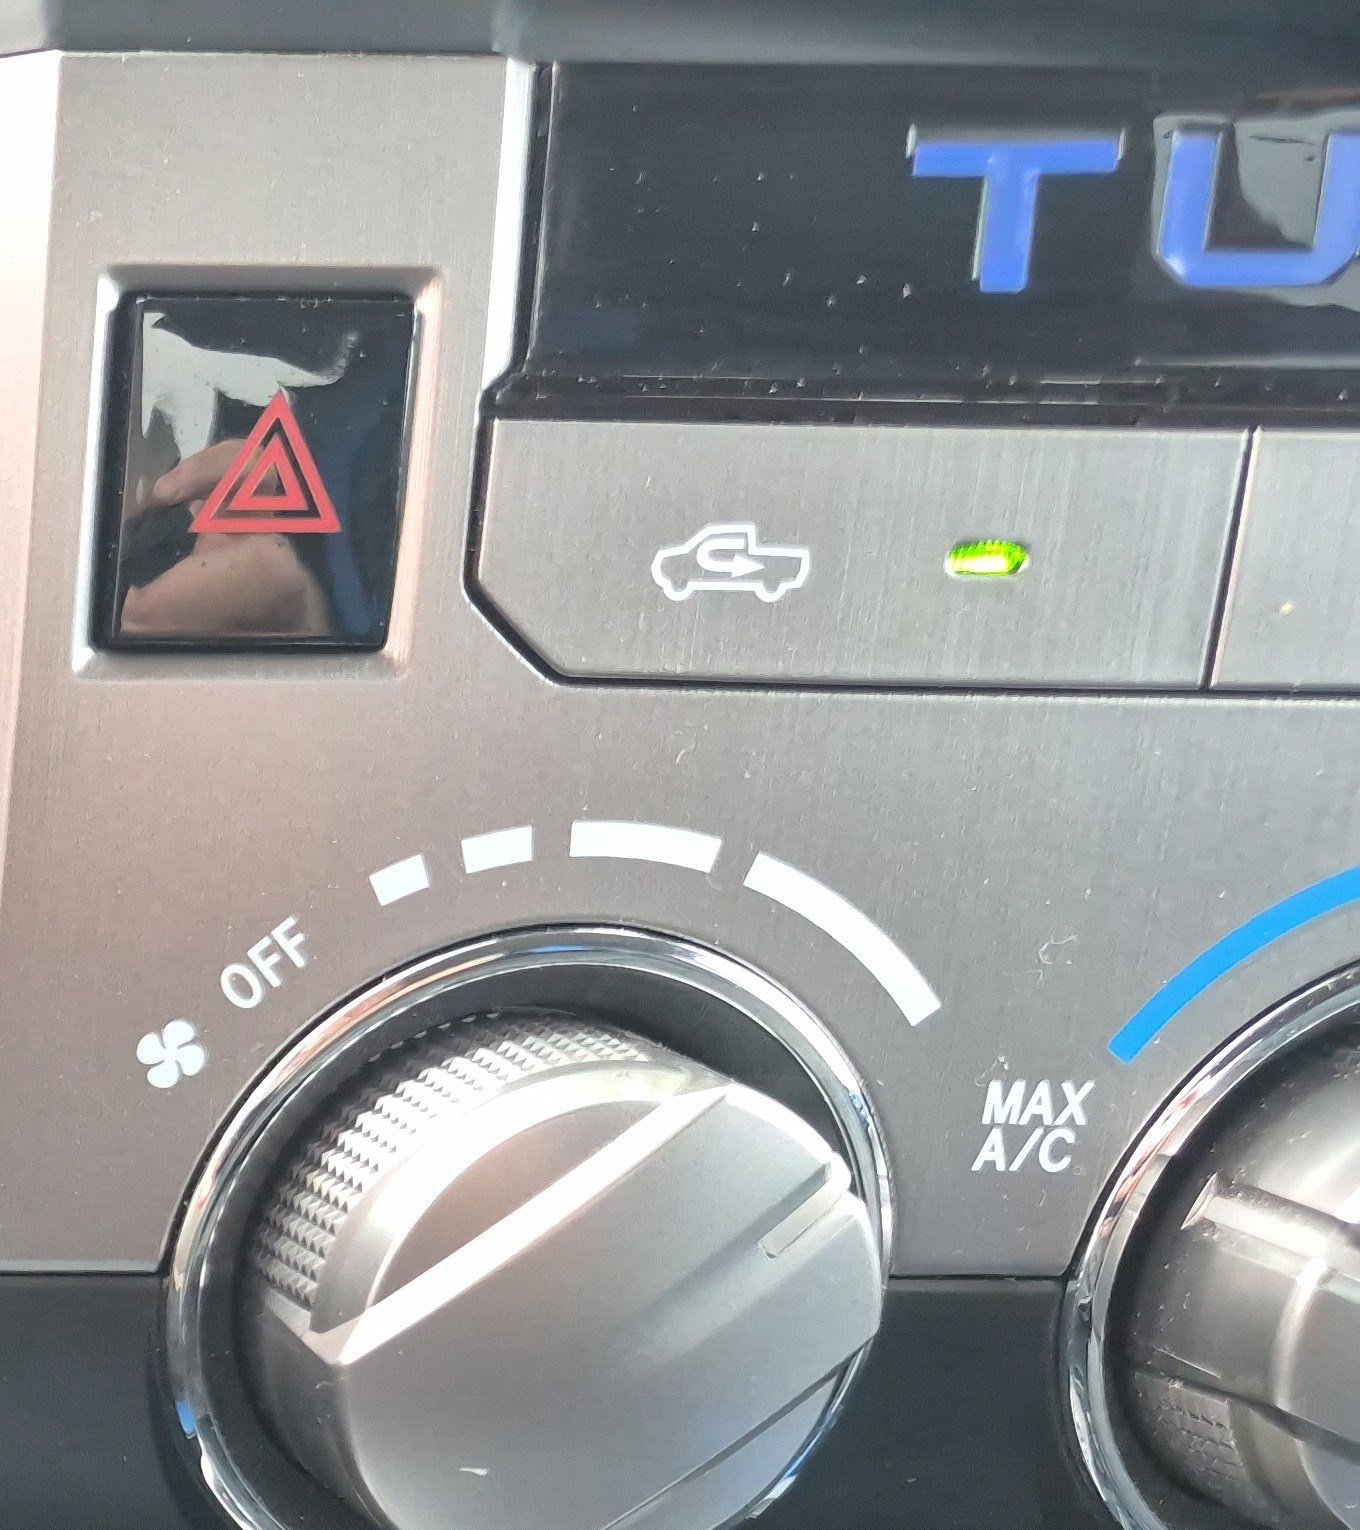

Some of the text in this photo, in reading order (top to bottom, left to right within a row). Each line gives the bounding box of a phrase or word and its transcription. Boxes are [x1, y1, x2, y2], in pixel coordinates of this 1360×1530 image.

[219, 915, 307, 1010] OFF
[981, 1078, 1096, 1126] MAX
[970, 1126, 1077, 1173] A/C
